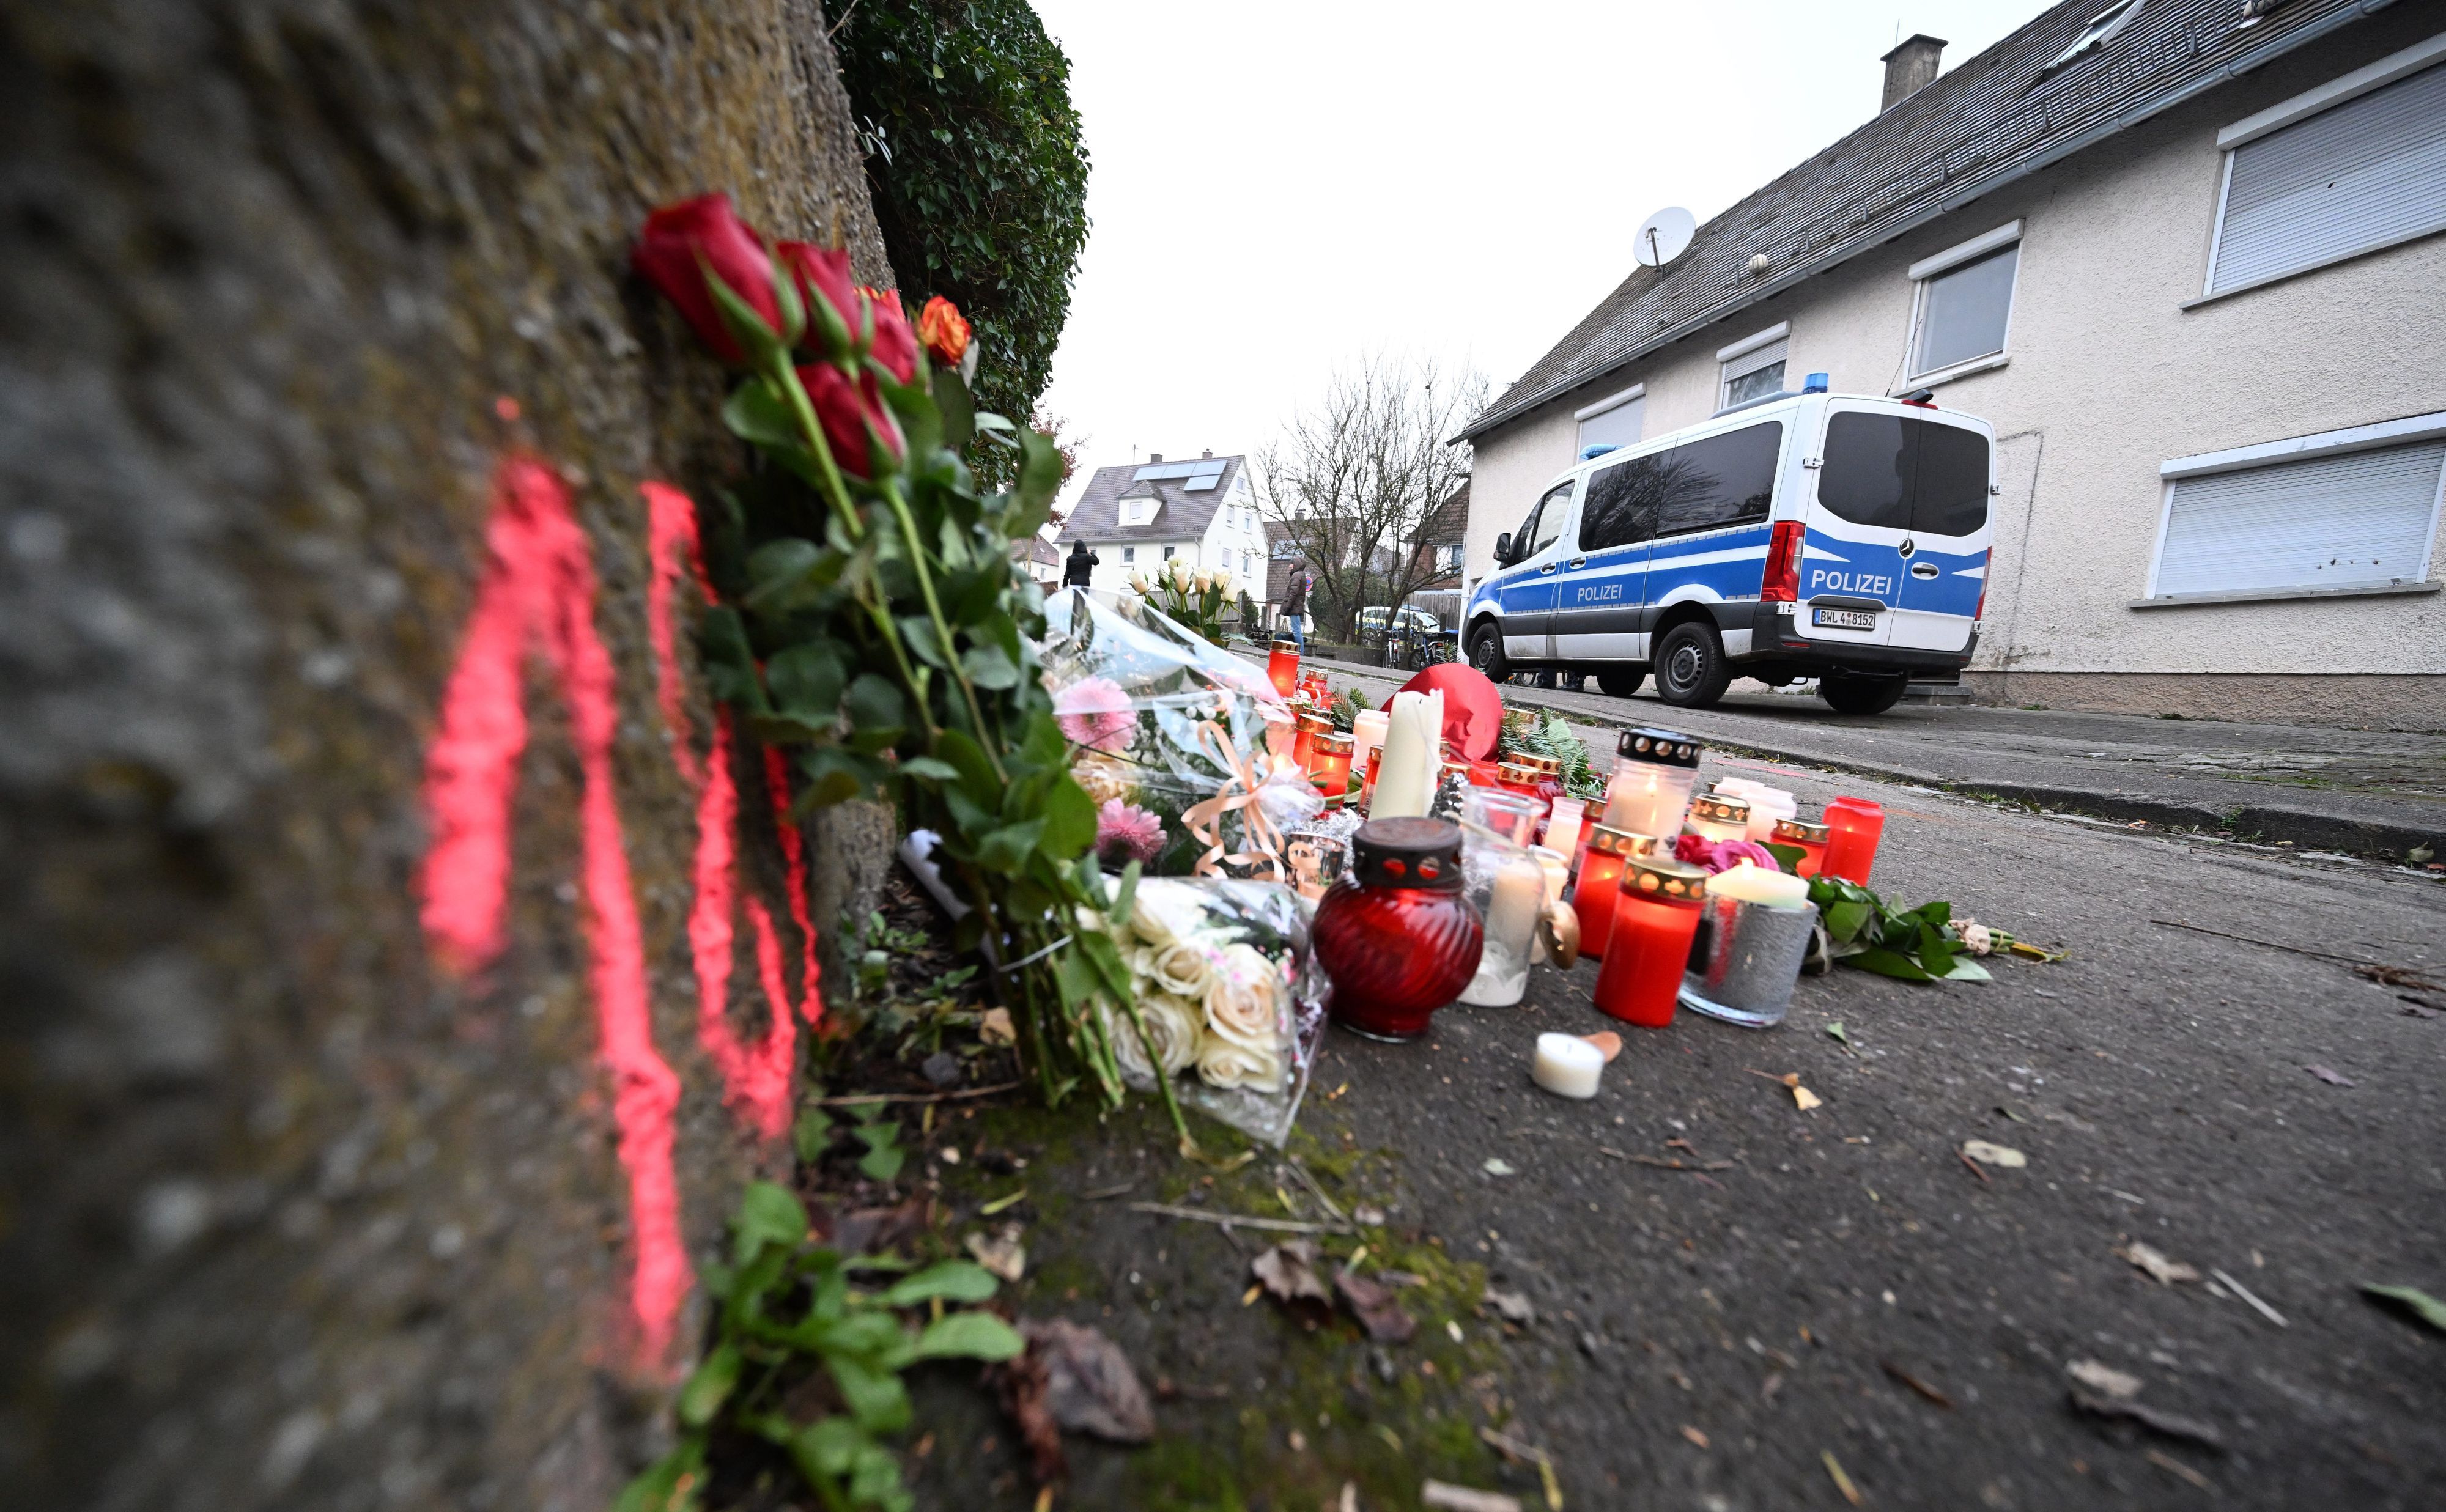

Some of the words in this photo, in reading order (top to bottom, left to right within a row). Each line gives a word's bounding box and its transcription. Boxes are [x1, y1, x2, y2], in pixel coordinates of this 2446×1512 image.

[1811, 569, 1892, 595] POLIZEI
[1578, 584, 1622, 602] POLIZEI
[1820, 611, 1838, 623] BWL
[1840, 613, 1846, 624] 4
[1852, 613, 1874, 626] 8152
